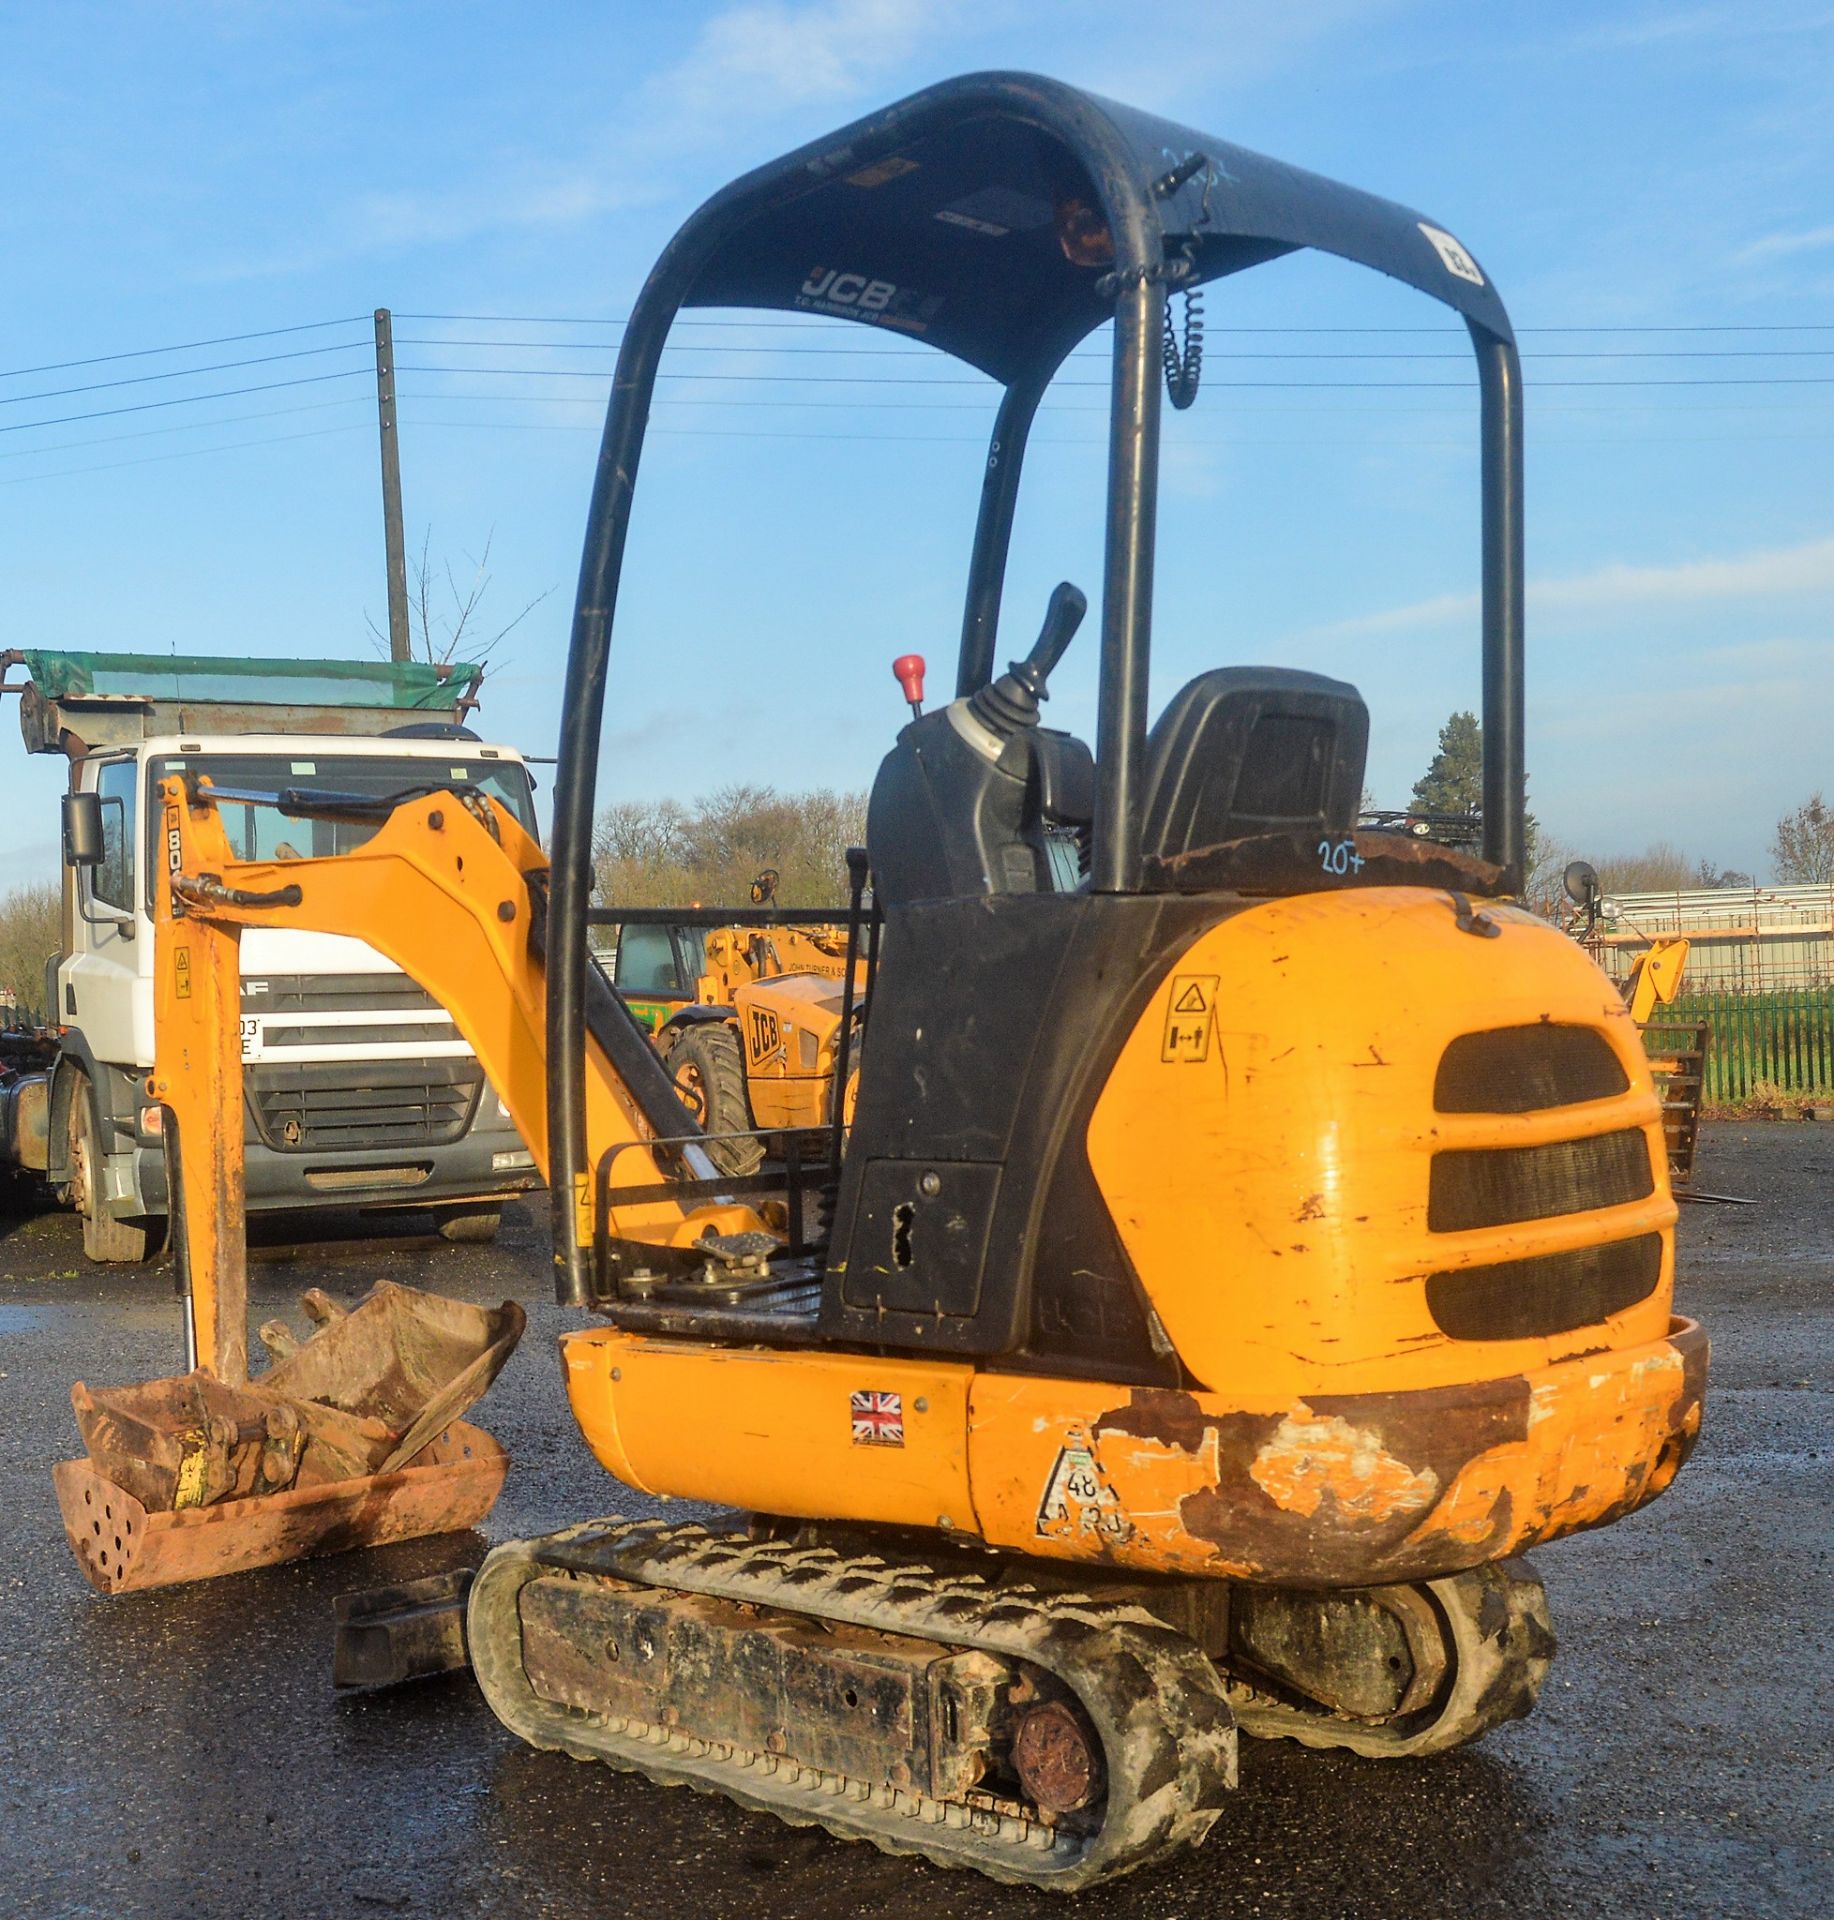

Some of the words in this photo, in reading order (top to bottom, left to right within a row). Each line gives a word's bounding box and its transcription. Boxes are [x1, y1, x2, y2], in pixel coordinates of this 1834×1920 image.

[802, 266, 897, 310] JCB
[788, 962, 805, 972] JOHN
[806, 963, 830, 975] TURNER
[241, 1039, 251, 1054] E
[752, 1010, 778, 1058] JCB
